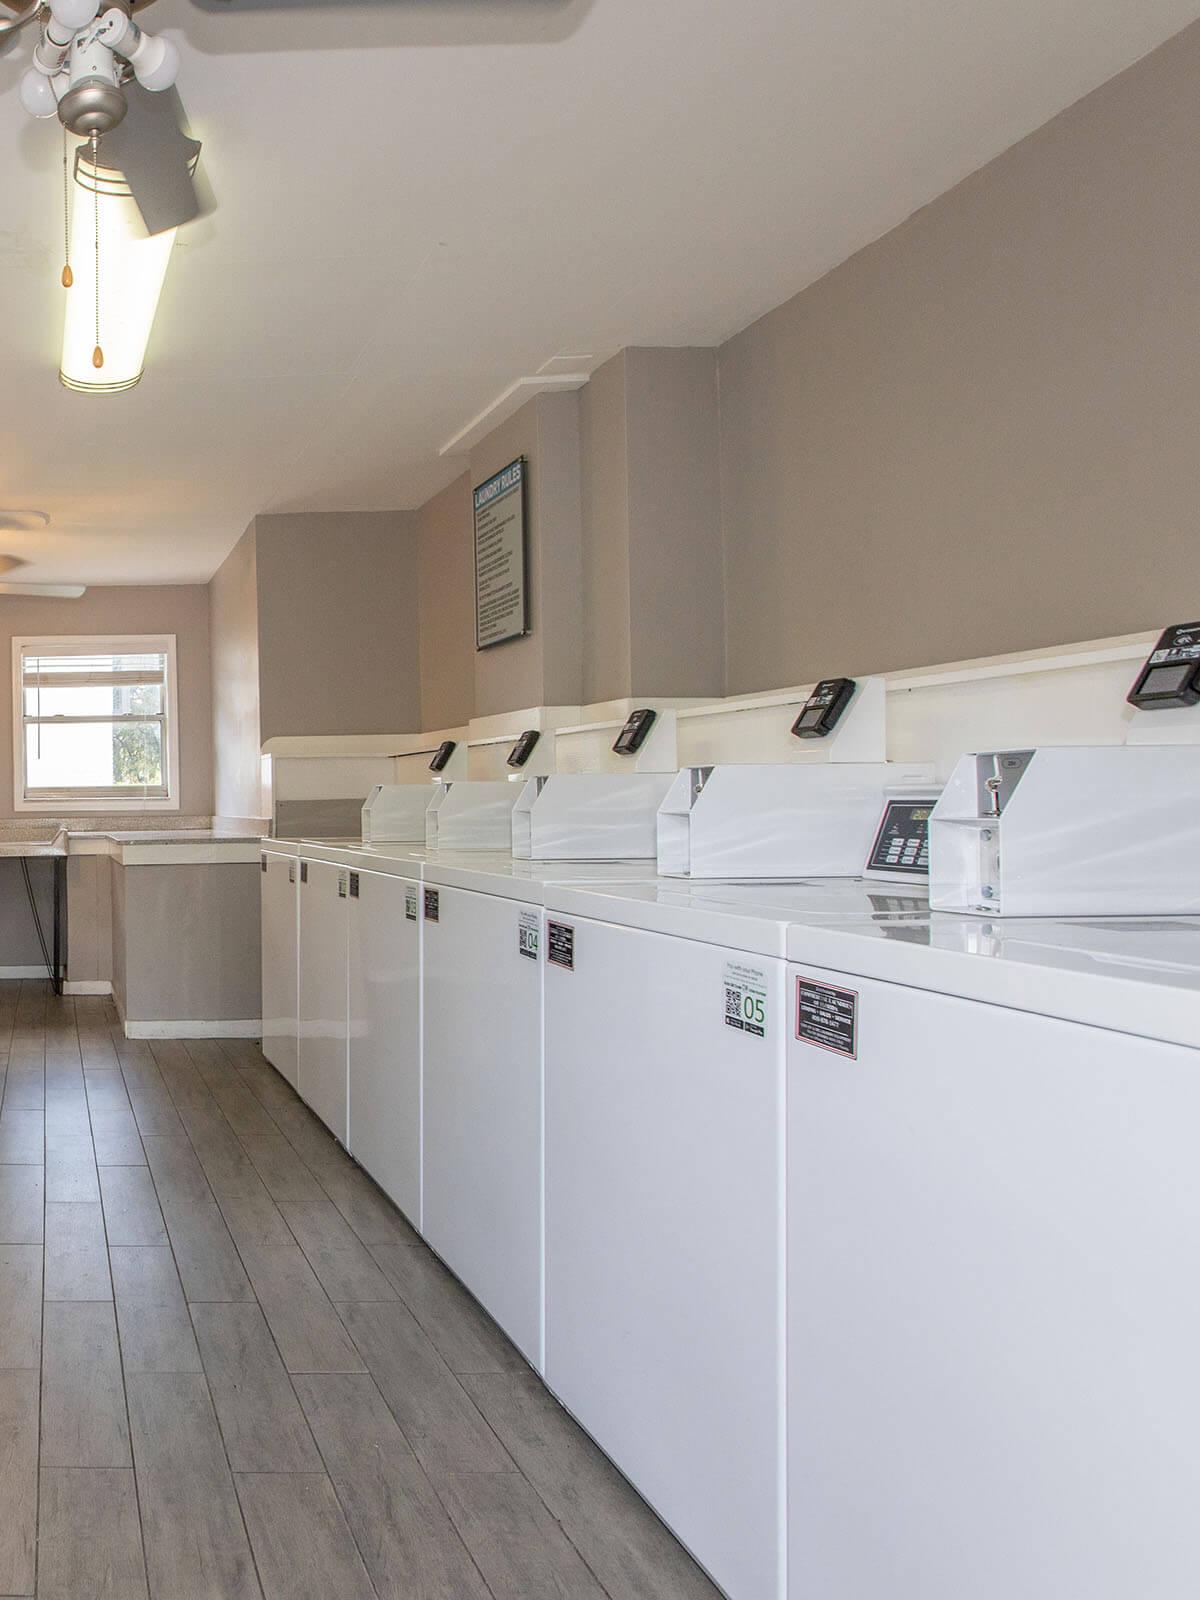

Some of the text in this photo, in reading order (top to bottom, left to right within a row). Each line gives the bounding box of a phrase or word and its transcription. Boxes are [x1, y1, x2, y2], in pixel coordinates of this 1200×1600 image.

[475, 464, 521, 508] LAUNDRY RULES
[528, 932, 538, 951] 04
[744, 996, 764, 1023] 05
